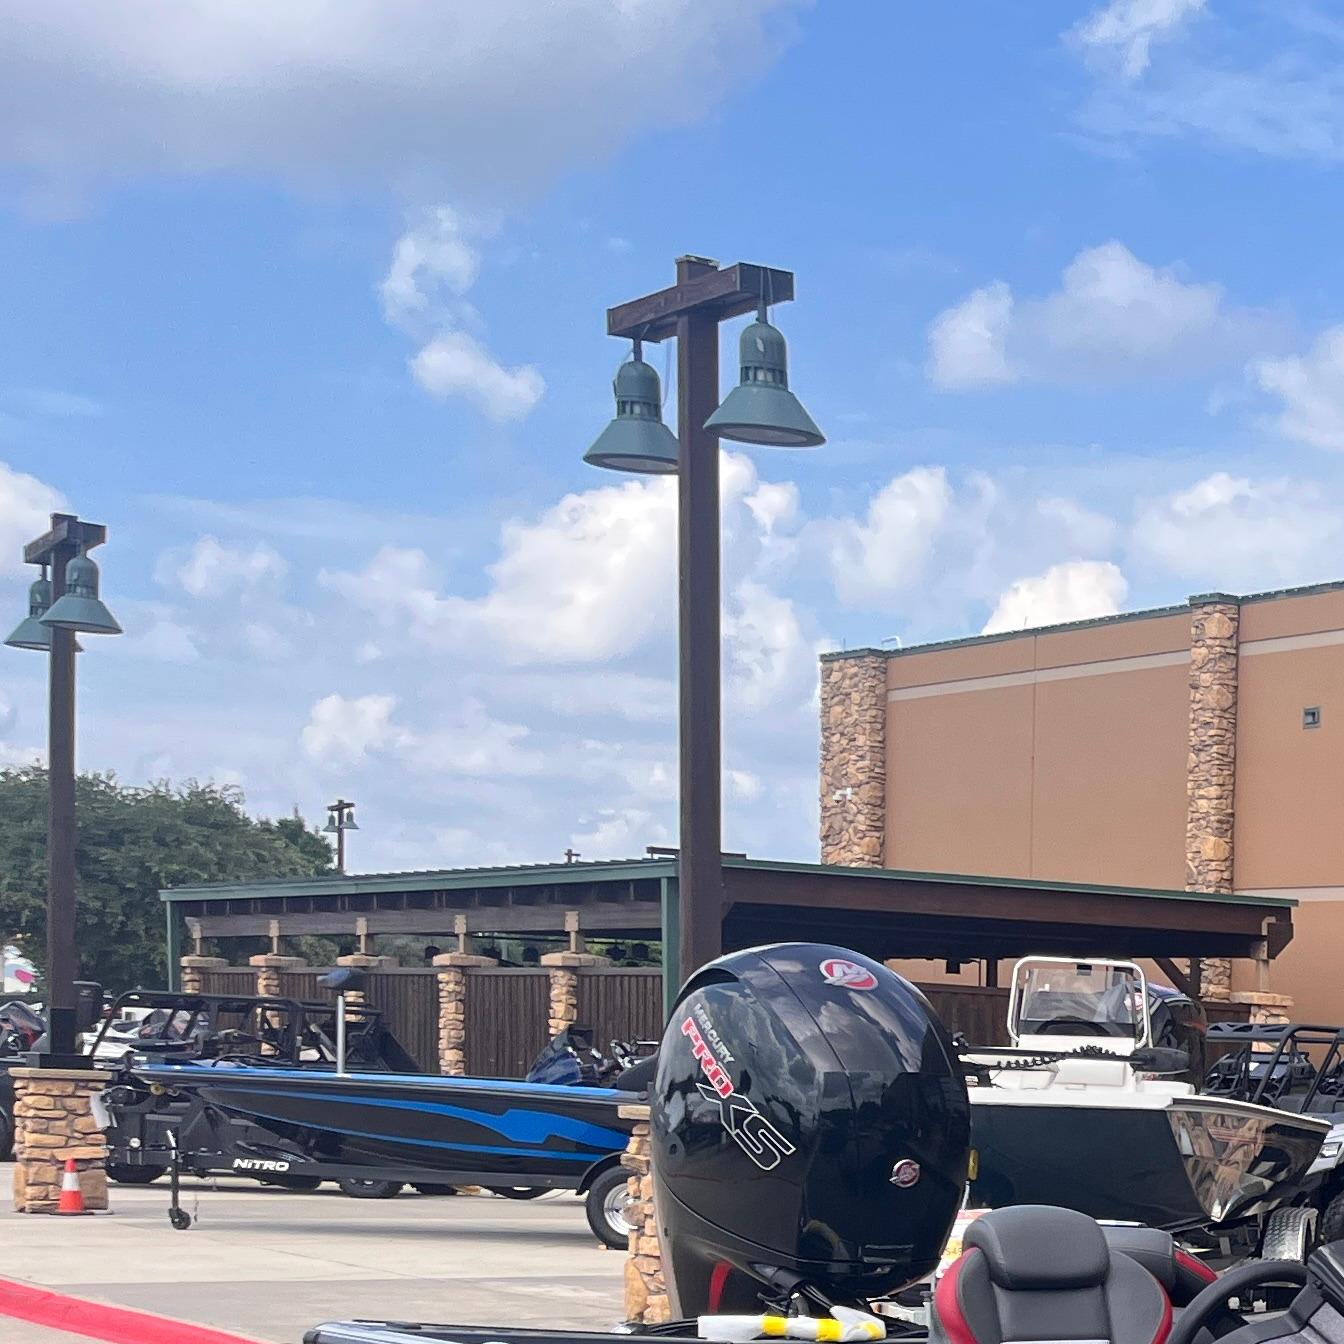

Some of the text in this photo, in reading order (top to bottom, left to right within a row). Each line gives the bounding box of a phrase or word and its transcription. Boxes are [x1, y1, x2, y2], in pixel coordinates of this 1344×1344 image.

[693, 1003, 735, 1063] MERCURY
[681, 1017, 796, 1171] PRO XS
